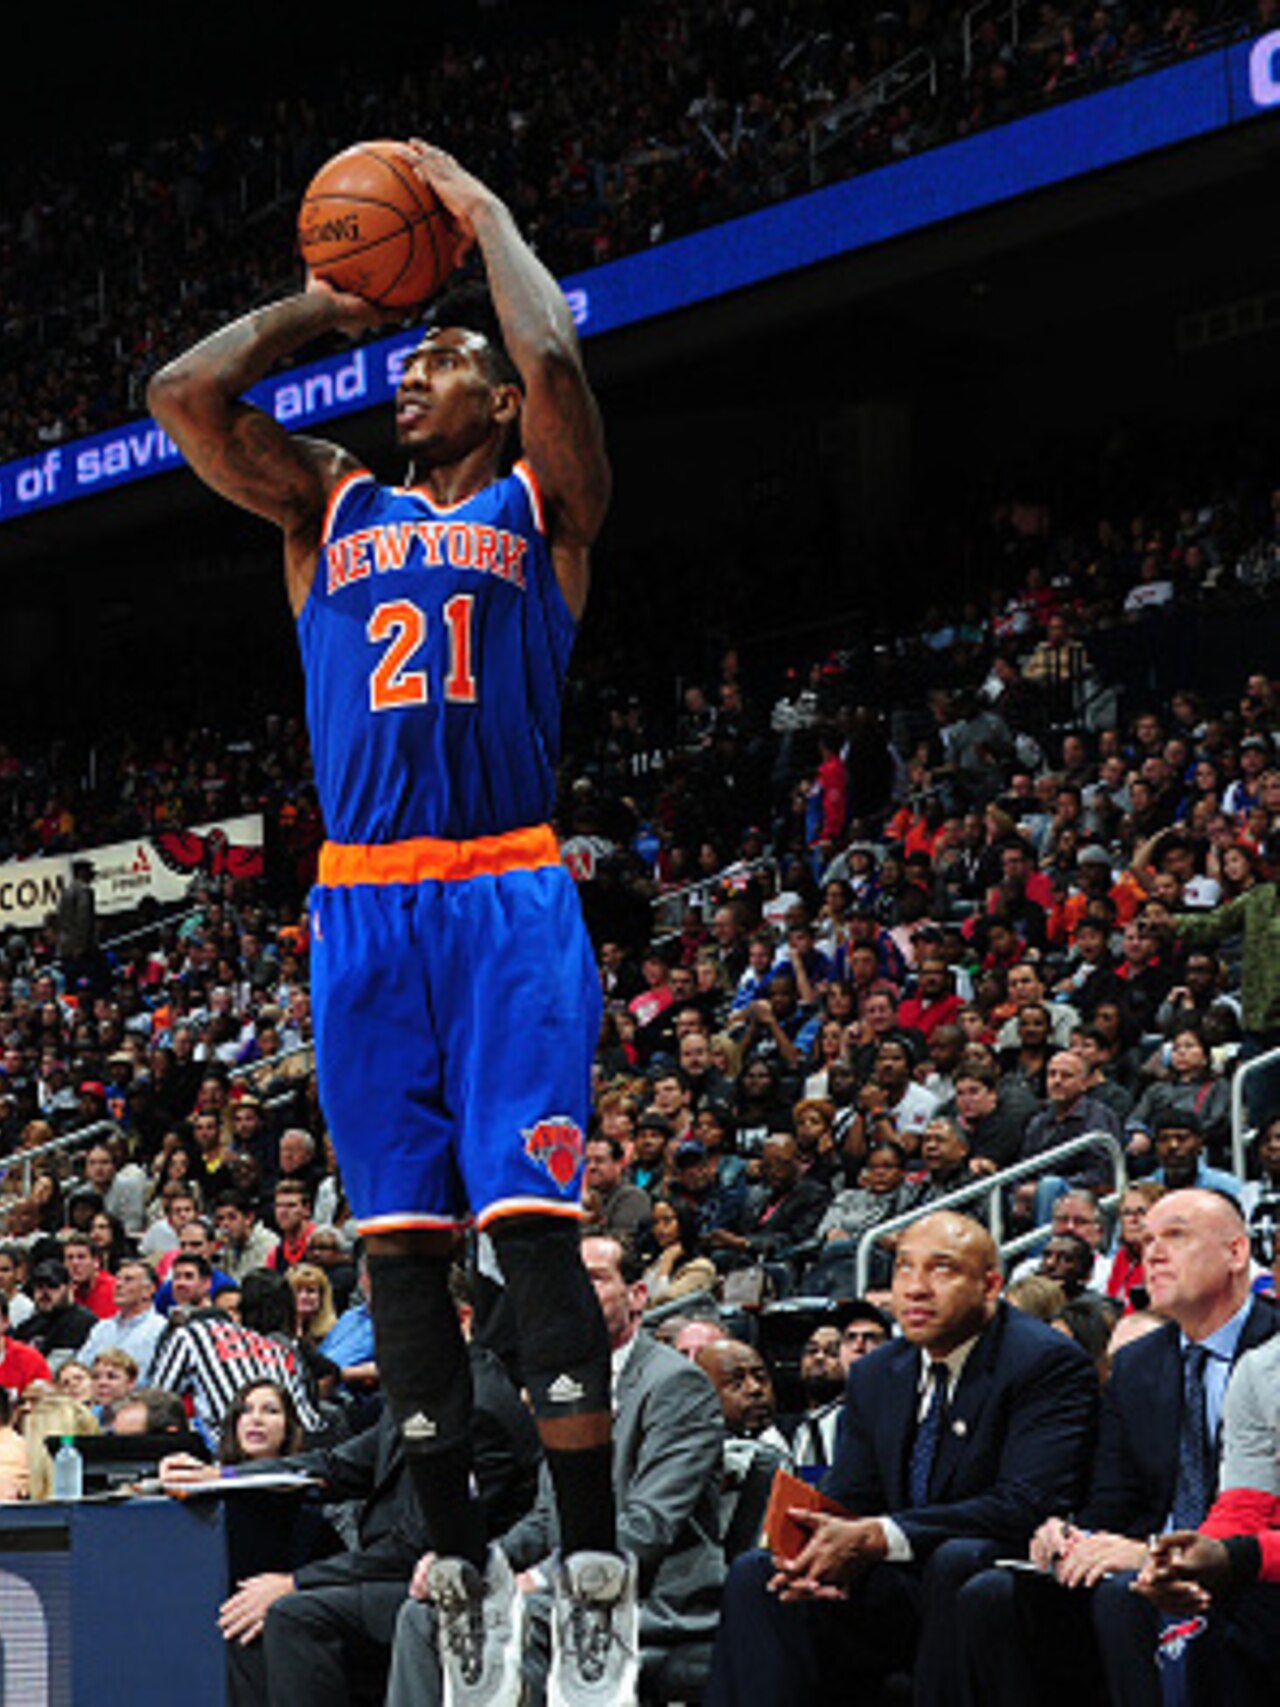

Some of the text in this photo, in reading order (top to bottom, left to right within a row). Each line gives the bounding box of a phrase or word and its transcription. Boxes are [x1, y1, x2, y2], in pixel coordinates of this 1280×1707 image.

[16, 449, 61, 501] of
[76, 427, 179, 485] savi
[274, 352, 365, 421] and
[326, 521, 528, 596] NEW YORK
[367, 594, 477, 712] 21
